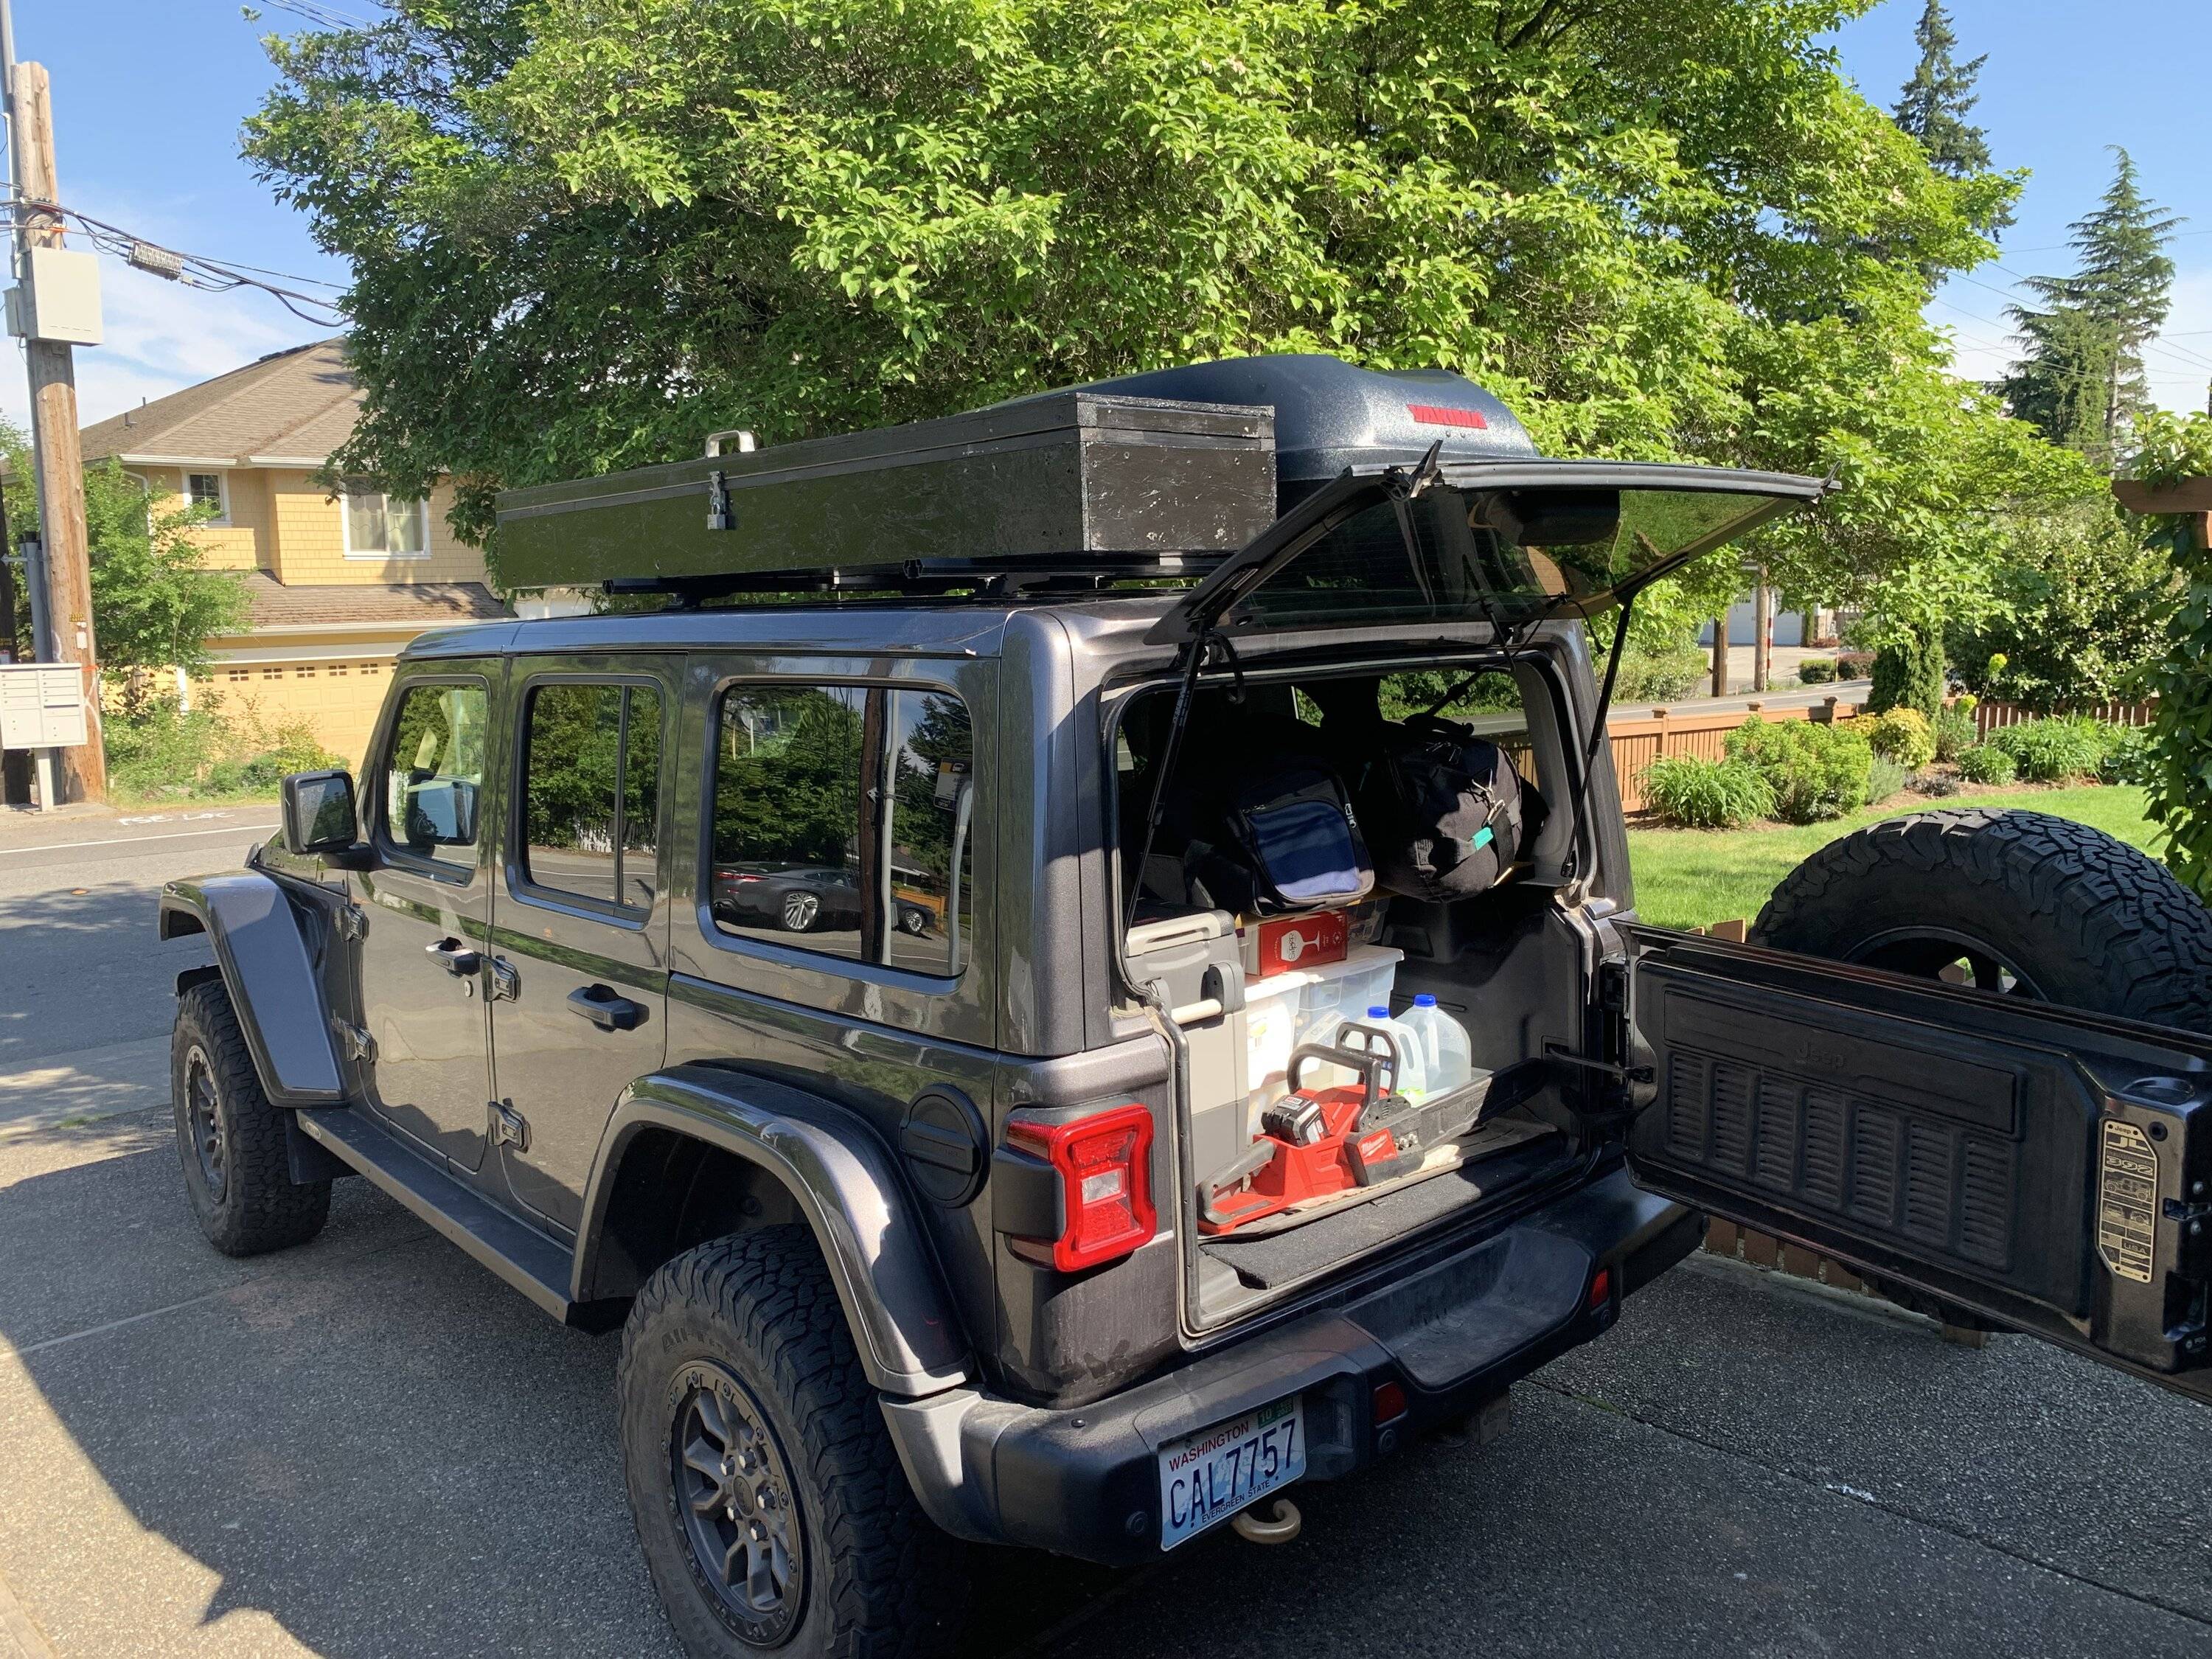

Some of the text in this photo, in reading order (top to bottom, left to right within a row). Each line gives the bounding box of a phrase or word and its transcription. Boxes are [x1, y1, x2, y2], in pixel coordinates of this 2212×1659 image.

[1406, 404, 1488, 429] YAKIMA
[2115, 1126, 2132, 1134] Jeep
[2106, 1155, 2154, 1176] 392
[1169, 1421, 1249, 1472] WASHINGTON
[1202, 1480, 1270, 1523] EVERGREEN STATE
